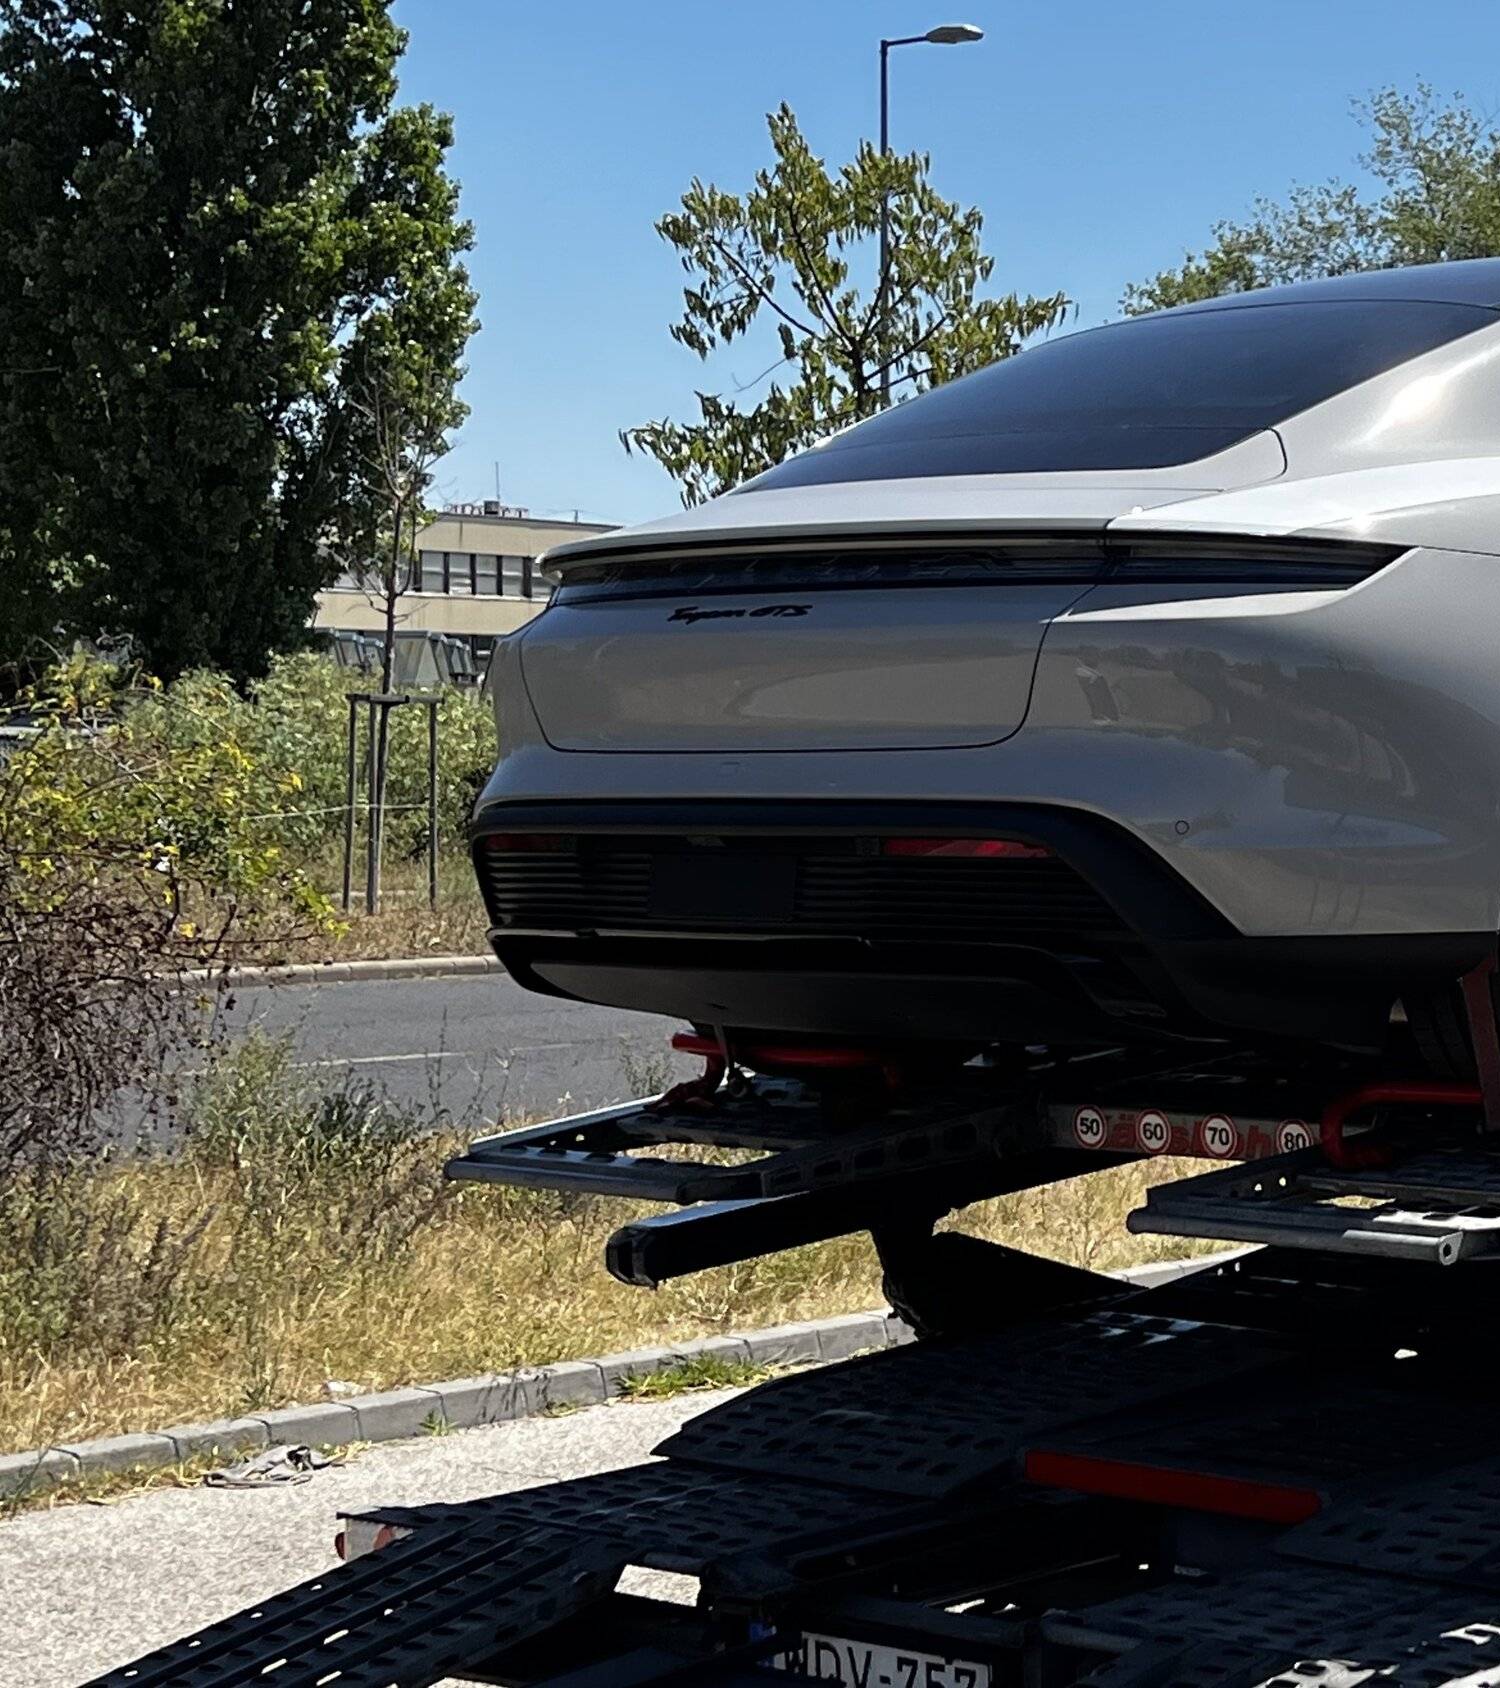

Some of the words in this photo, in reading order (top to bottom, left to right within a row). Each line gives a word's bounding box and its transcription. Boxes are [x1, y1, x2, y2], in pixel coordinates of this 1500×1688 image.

[749, 604, 814, 618] GTS
[1079, 1117, 1100, 1136] 50
[1142, 1122, 1165, 1141] 60
[1207, 1126, 1230, 1146] 70
[1283, 1132, 1306, 1152] 80
